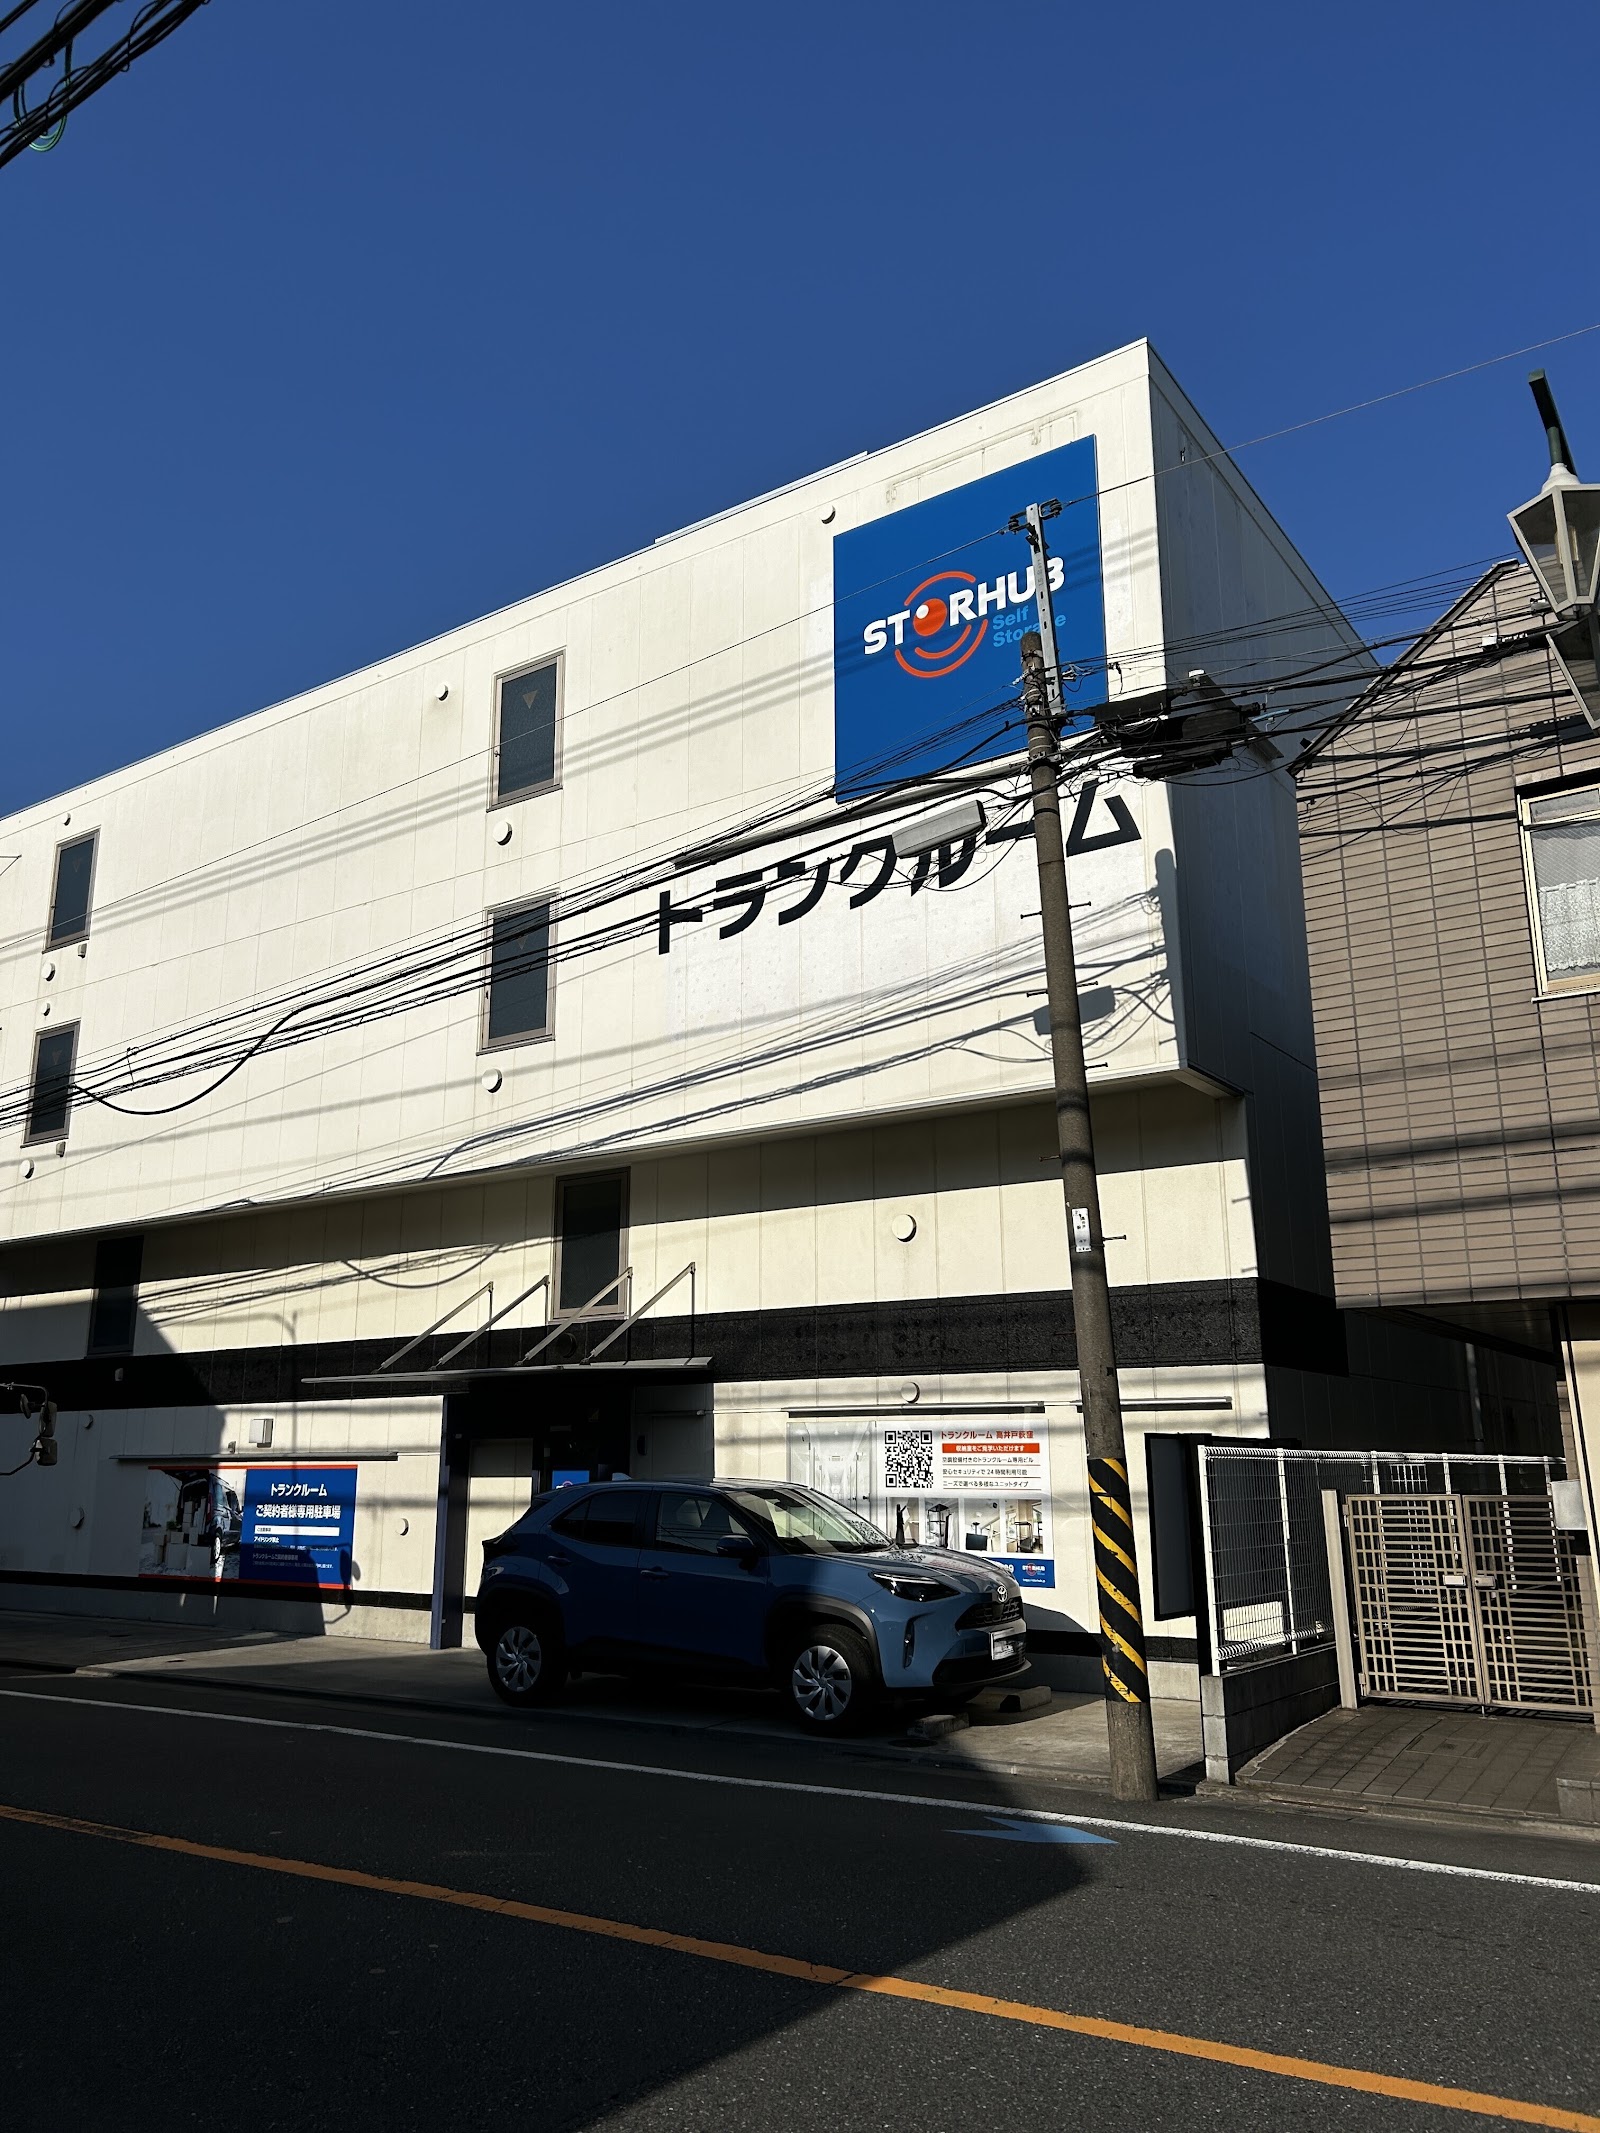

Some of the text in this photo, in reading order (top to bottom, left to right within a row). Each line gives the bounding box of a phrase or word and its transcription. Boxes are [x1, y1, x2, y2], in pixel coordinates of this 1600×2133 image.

[863, 556, 1065, 655] STORHUB
[992, 605, 1029, 631] Self
[941, 1430, 1034, 1440] トランクルーム 高井戸荻窪
[270, 1483, 328, 1497] トランクルーム
[255, 1504, 341, 1520] ご契約者様専用駐車場
